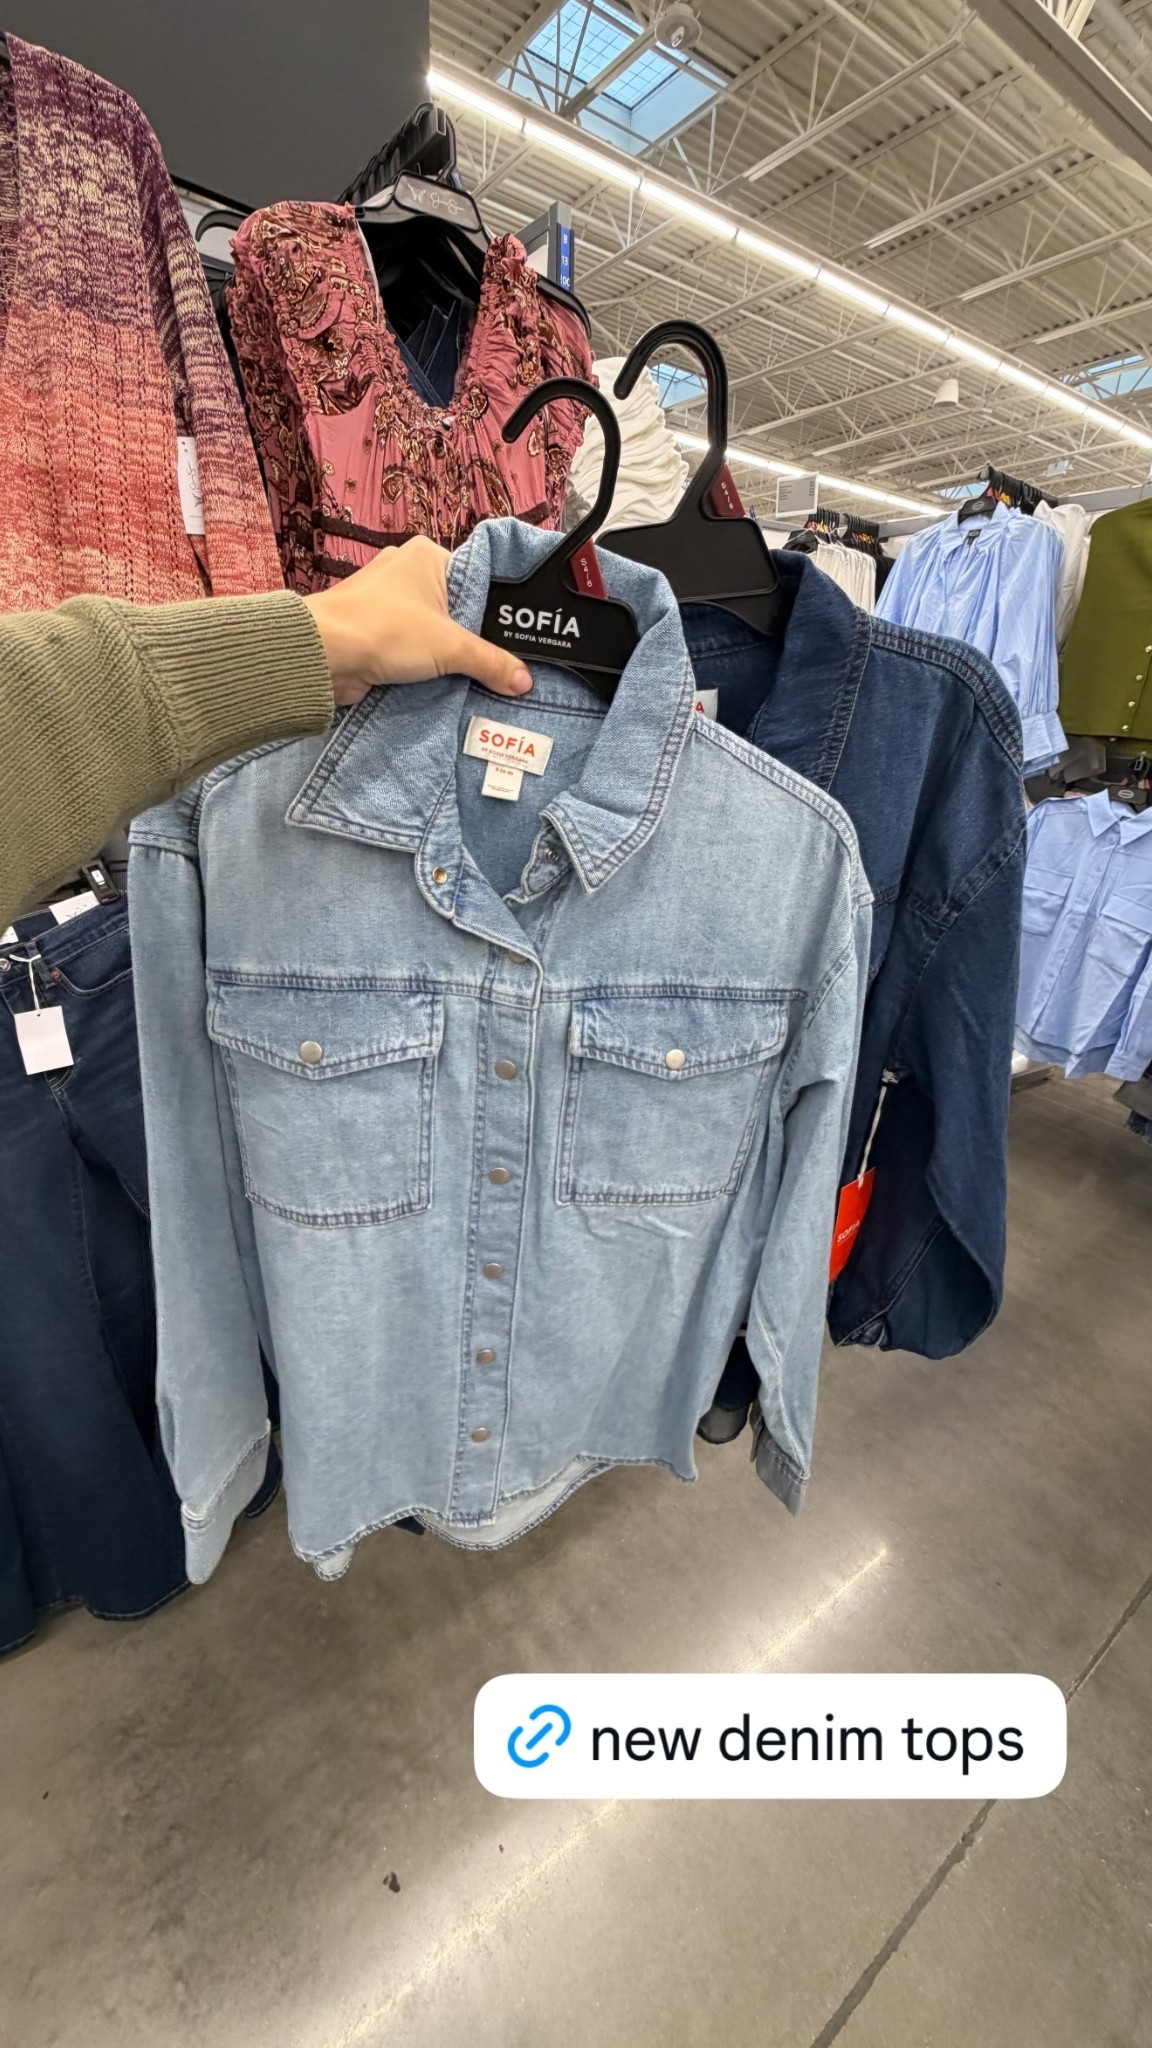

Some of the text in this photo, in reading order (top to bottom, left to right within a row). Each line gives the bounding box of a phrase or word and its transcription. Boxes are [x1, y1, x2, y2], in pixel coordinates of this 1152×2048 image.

[562, 255, 569, 266] 13
[498, 604, 580, 638] SOFÍA
[503, 630, 572, 649] BY SOFIA VERGARA
[479, 729, 535, 758] SOFÍA
